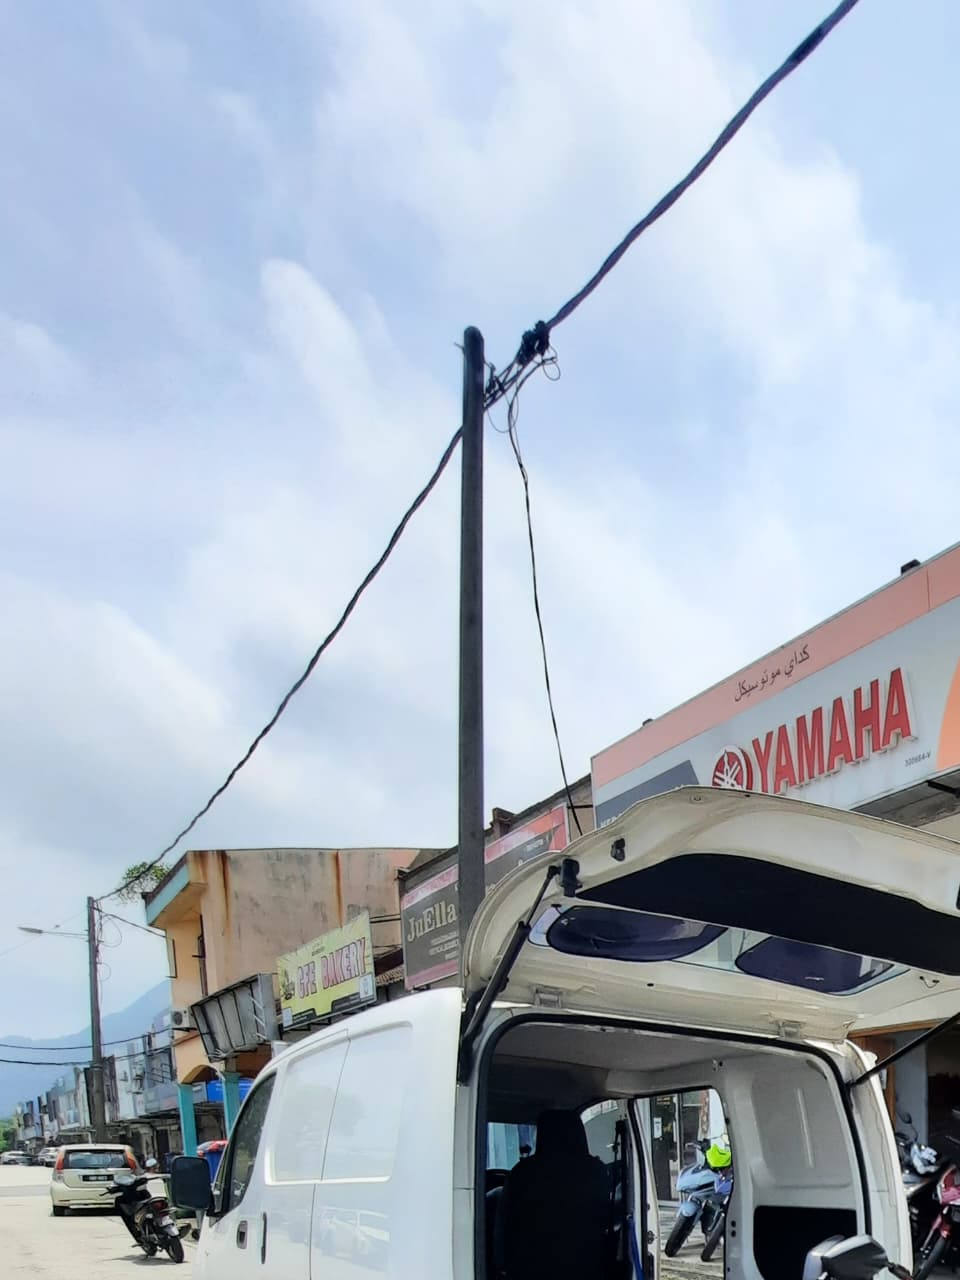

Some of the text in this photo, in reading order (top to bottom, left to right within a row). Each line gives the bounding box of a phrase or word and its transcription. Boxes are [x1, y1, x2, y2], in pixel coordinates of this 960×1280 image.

[752, 667, 911, 794] YAMAHA
[407, 899, 458, 941] JuElla
[320, 936, 366, 989] BAKERY
